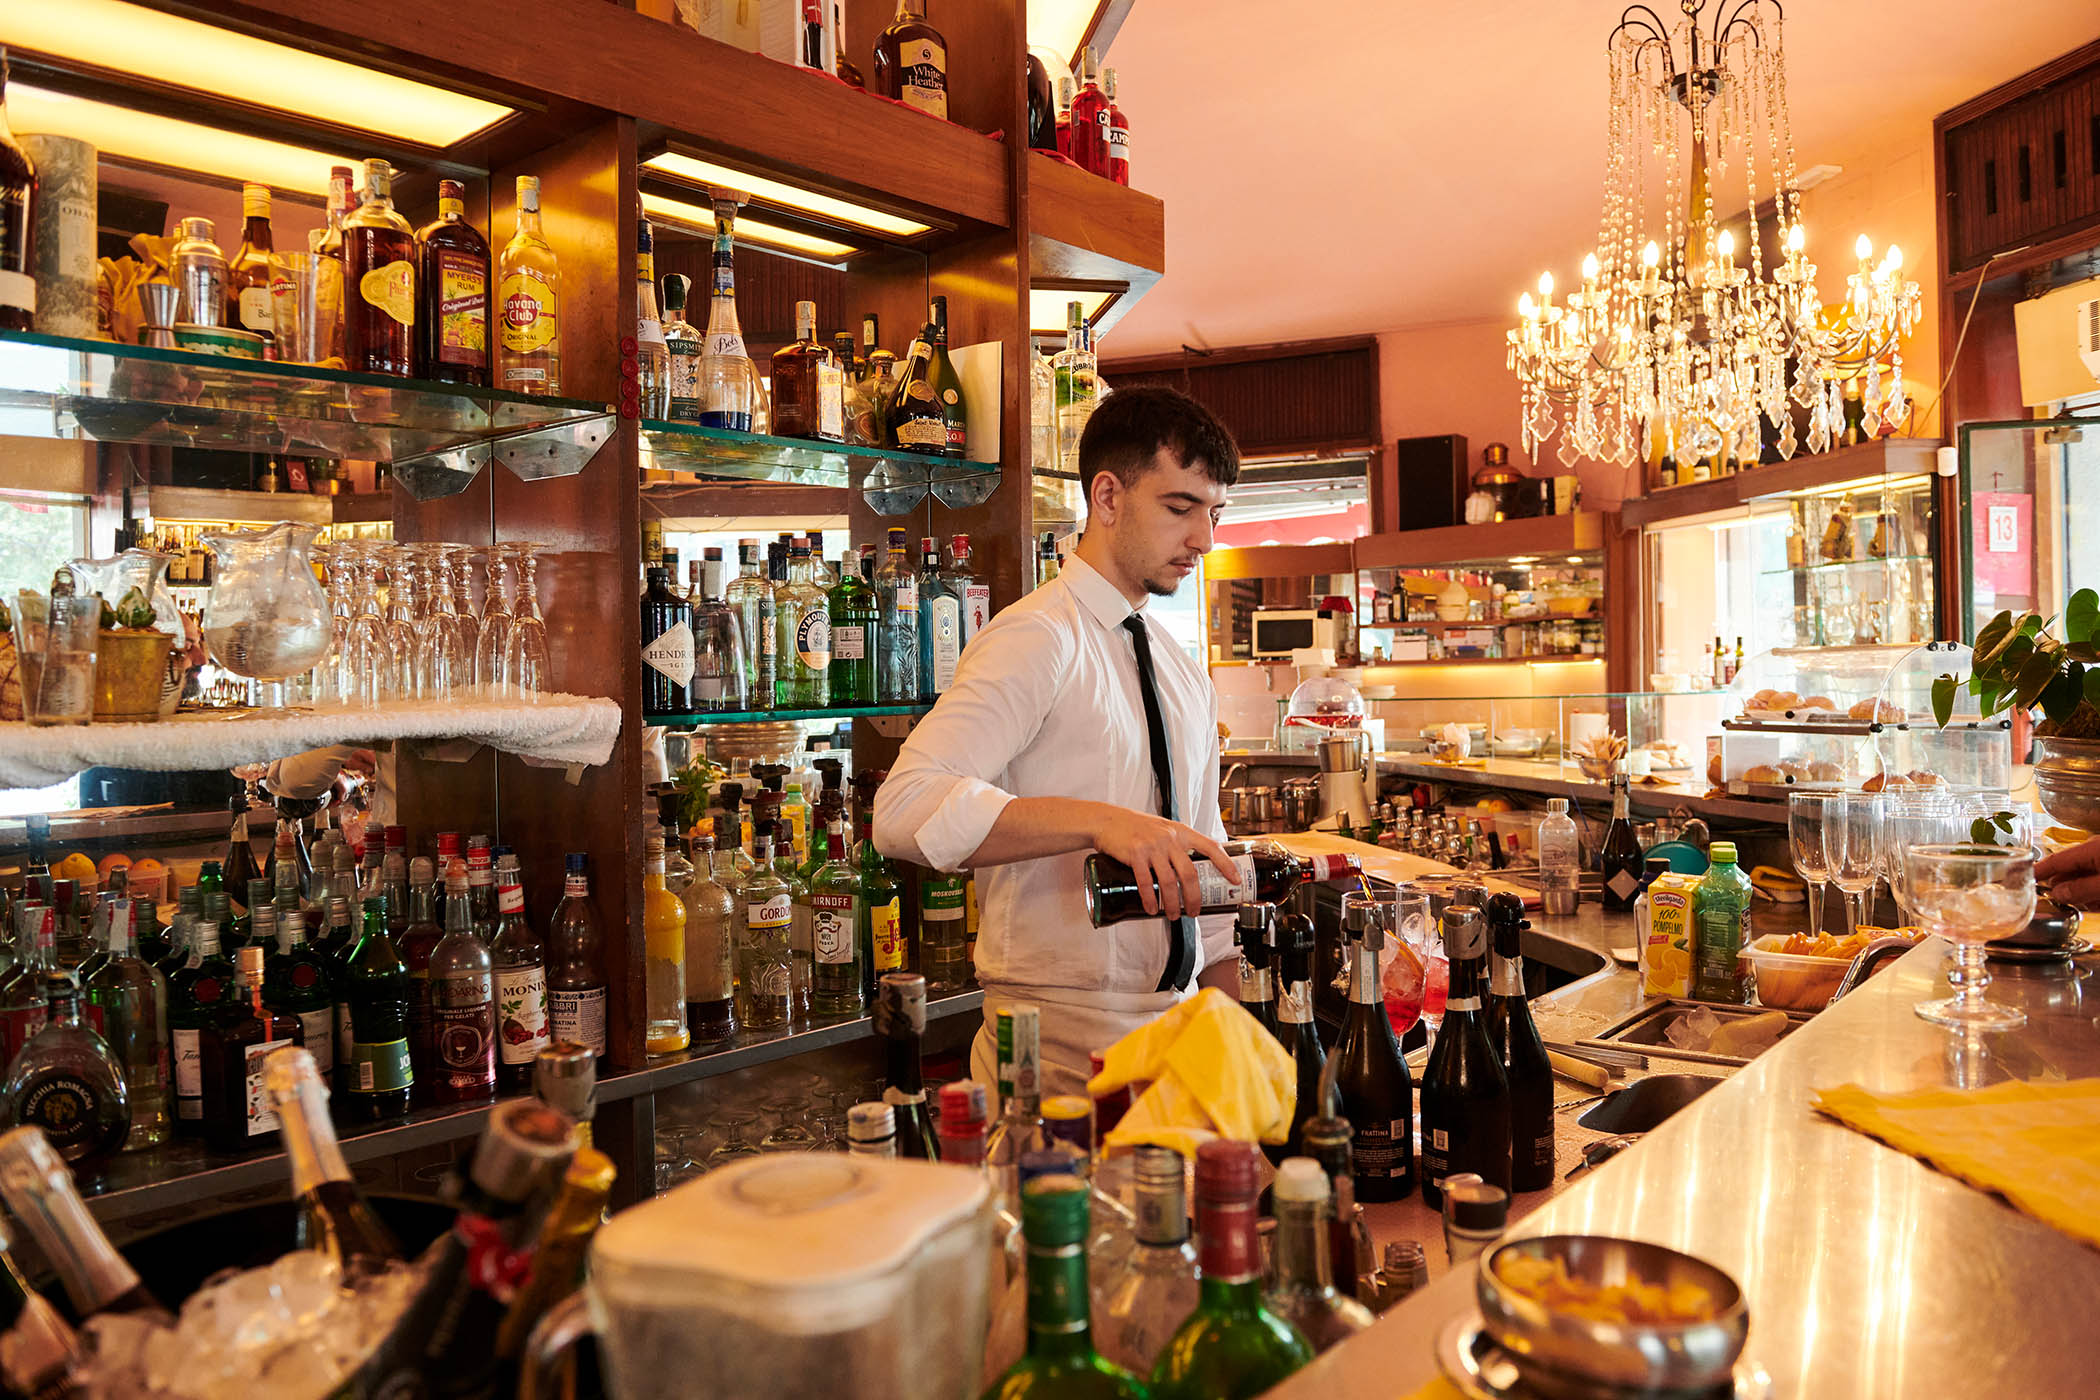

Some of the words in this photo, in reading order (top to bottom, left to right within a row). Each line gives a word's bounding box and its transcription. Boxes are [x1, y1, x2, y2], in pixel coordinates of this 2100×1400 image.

[913, 65, 941, 80] White
[908, 75, 944, 91] Heather
[457, 281, 476, 292] RUM
[503, 297, 543, 310] Havana
[508, 309, 534, 322] Club
[713, 335, 739, 355] Bols
[1994, 515, 2014, 541] 13
[966, 588, 989, 598] BEEFEATER
[1653, 919, 1684, 936] POMPELMO
[503, 980, 547, 997] MONIN
